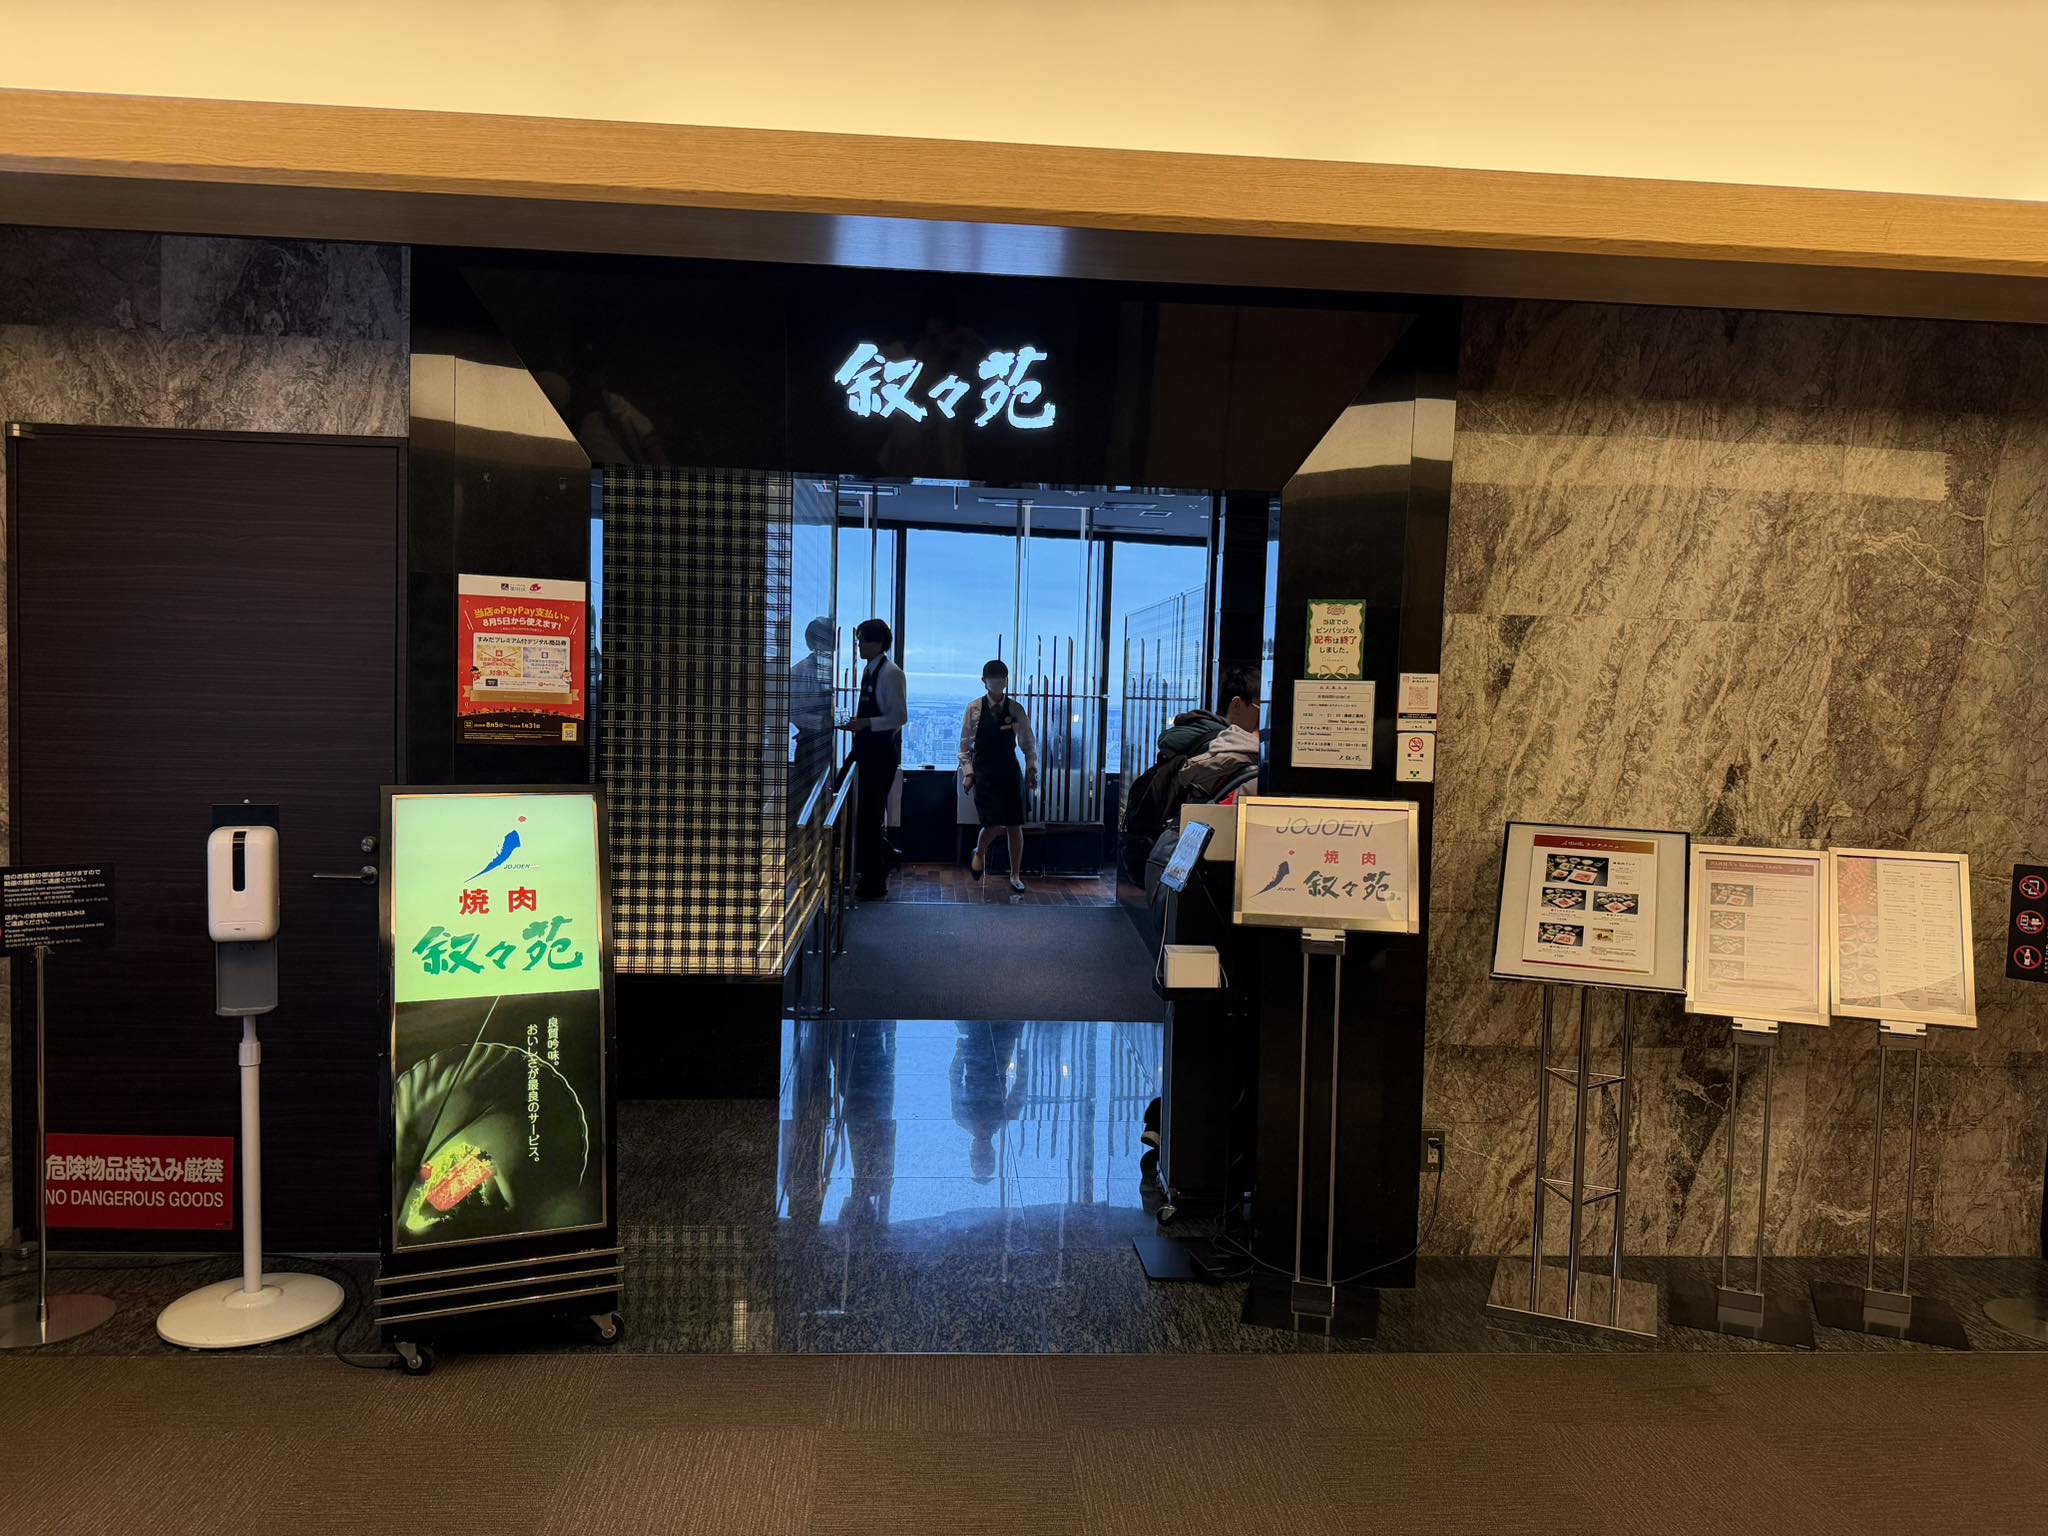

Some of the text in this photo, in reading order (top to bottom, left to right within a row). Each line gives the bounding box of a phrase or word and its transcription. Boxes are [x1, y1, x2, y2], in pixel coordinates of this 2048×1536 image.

[834, 343, 1056, 429] 叙々苑
[474, 606, 570, 622] 当店のPayPay支払いで
[1314, 635, 1358, 645] 配布は終了
[1319, 646, 1349, 654] しました。
[1276, 817, 1374, 838] JOJOEN
[1324, 849, 1377, 866] 焼肉
[1303, 870, 1400, 901] 叙々苑
[458, 886, 537, 915] 焼肉
[411, 915, 584, 975] 叙々苑
[547, 1016, 560, 1067] 良質吟味。
[526, 1023, 540, 1163] おいしさが最良のサービス。
[45, 1154, 224, 1183] 危険物品持込み厳禁
[45, 1189, 224, 1207] NO DANGEROUS GOODS
